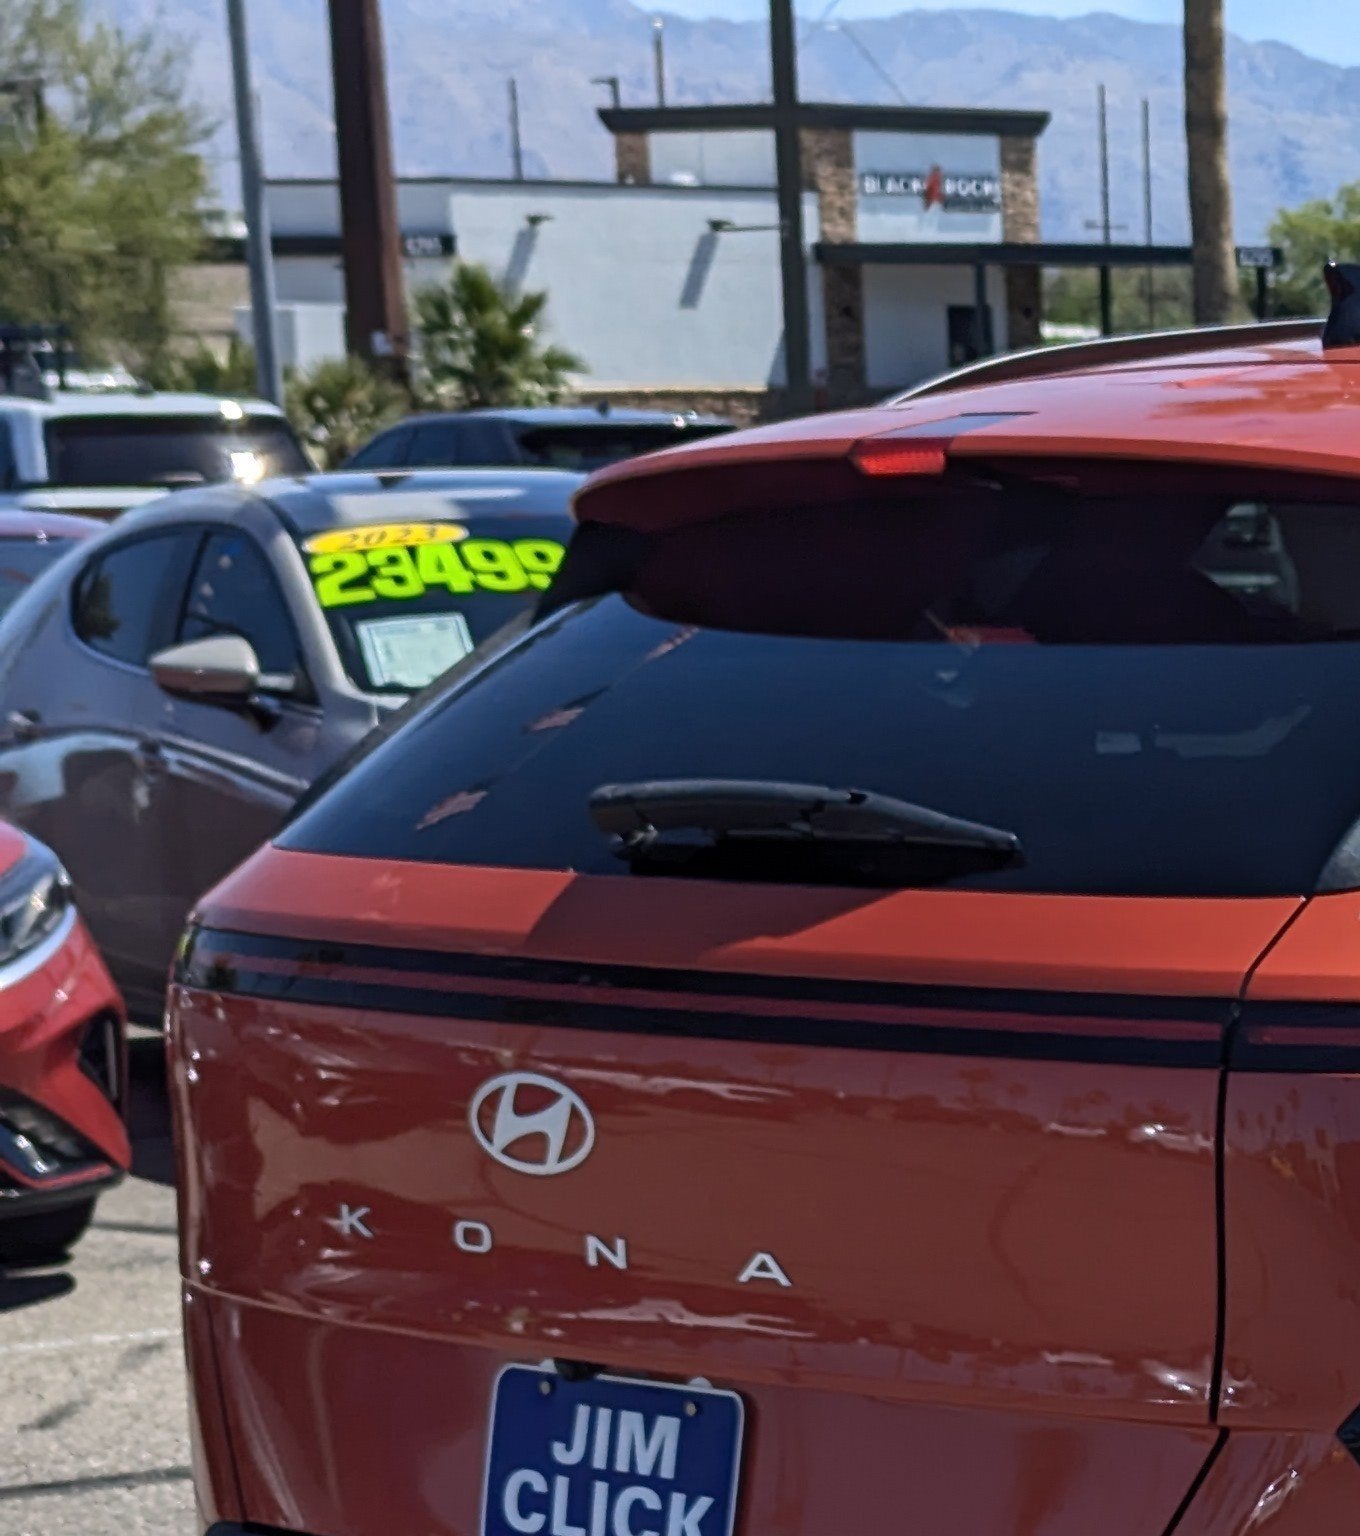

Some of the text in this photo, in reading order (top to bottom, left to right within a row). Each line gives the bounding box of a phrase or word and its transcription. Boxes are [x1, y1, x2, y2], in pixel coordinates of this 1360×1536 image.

[309, 539, 566, 608] 23499
[338, 1203, 792, 1288] KONA
[551, 1403, 682, 1481] JIM
